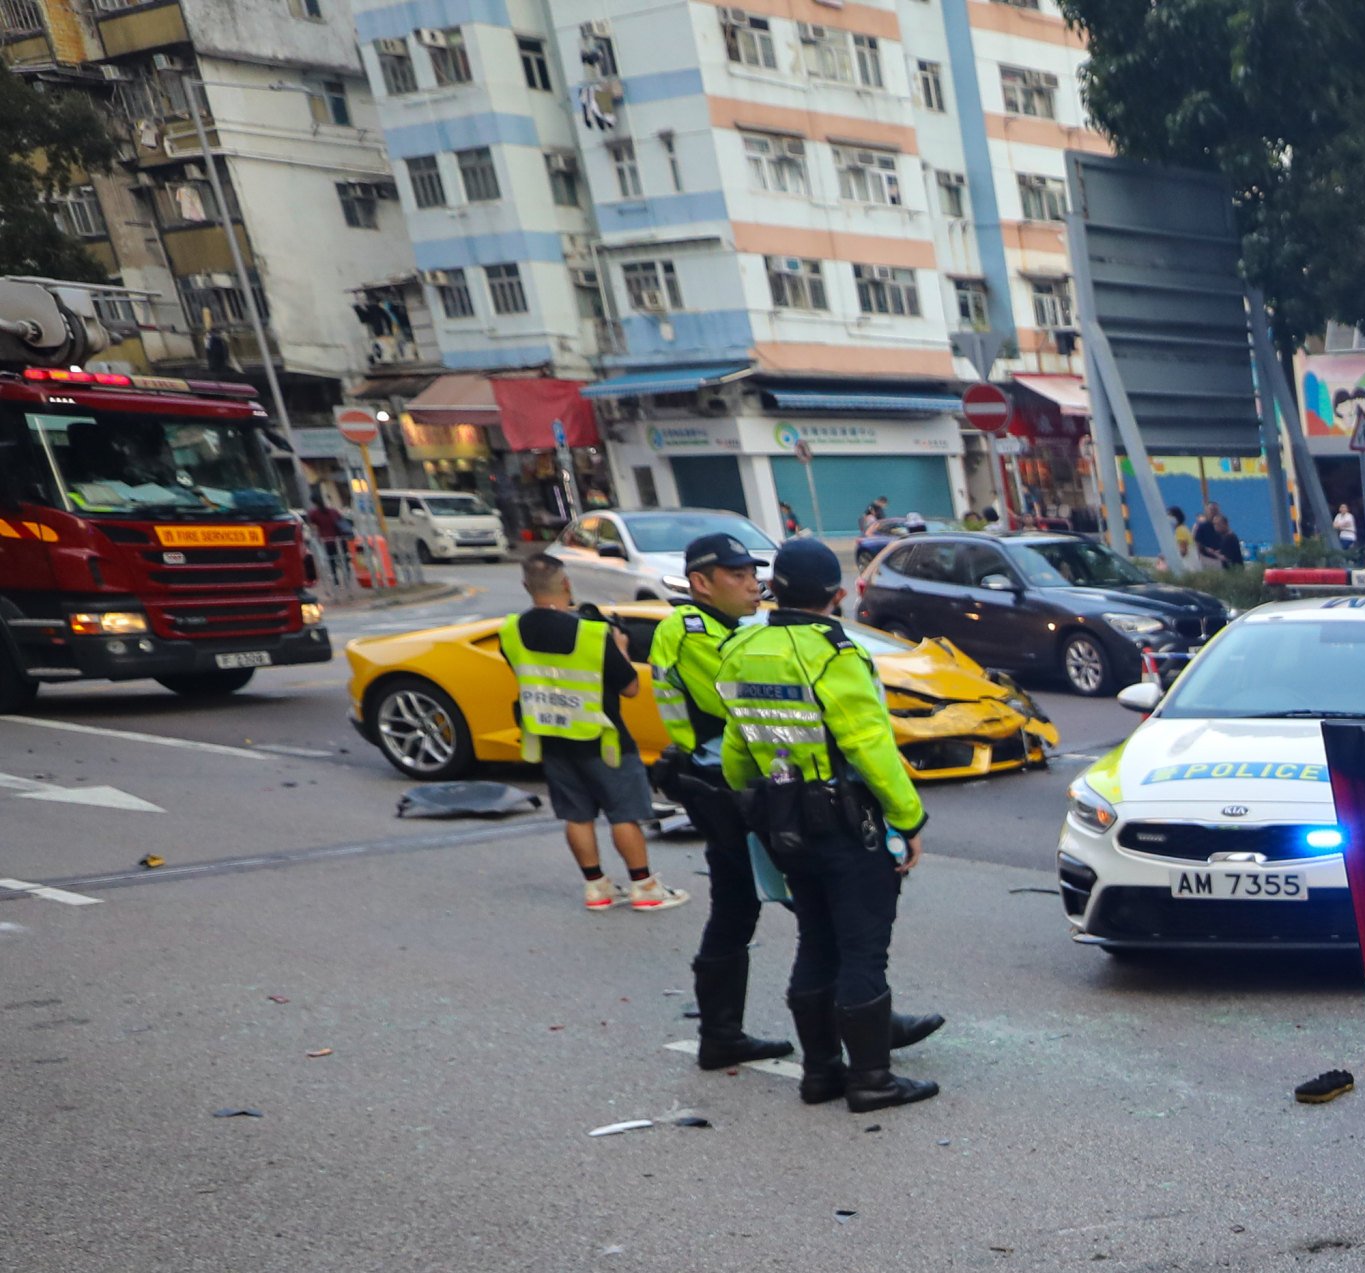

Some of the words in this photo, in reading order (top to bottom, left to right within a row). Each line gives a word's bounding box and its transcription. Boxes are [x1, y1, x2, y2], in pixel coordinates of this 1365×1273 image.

[176, 530, 198, 543] FIRE
[201, 530, 247, 543] SERVICES
[522, 690, 581, 708] PRESS
[744, 685, 783, 698] POLICE
[1183, 762, 1323, 781] POLICE
[1223, 806, 1246, 816] KIA
[1177, 872, 1213, 895] AM
[1224, 873, 1302, 896] 7355
